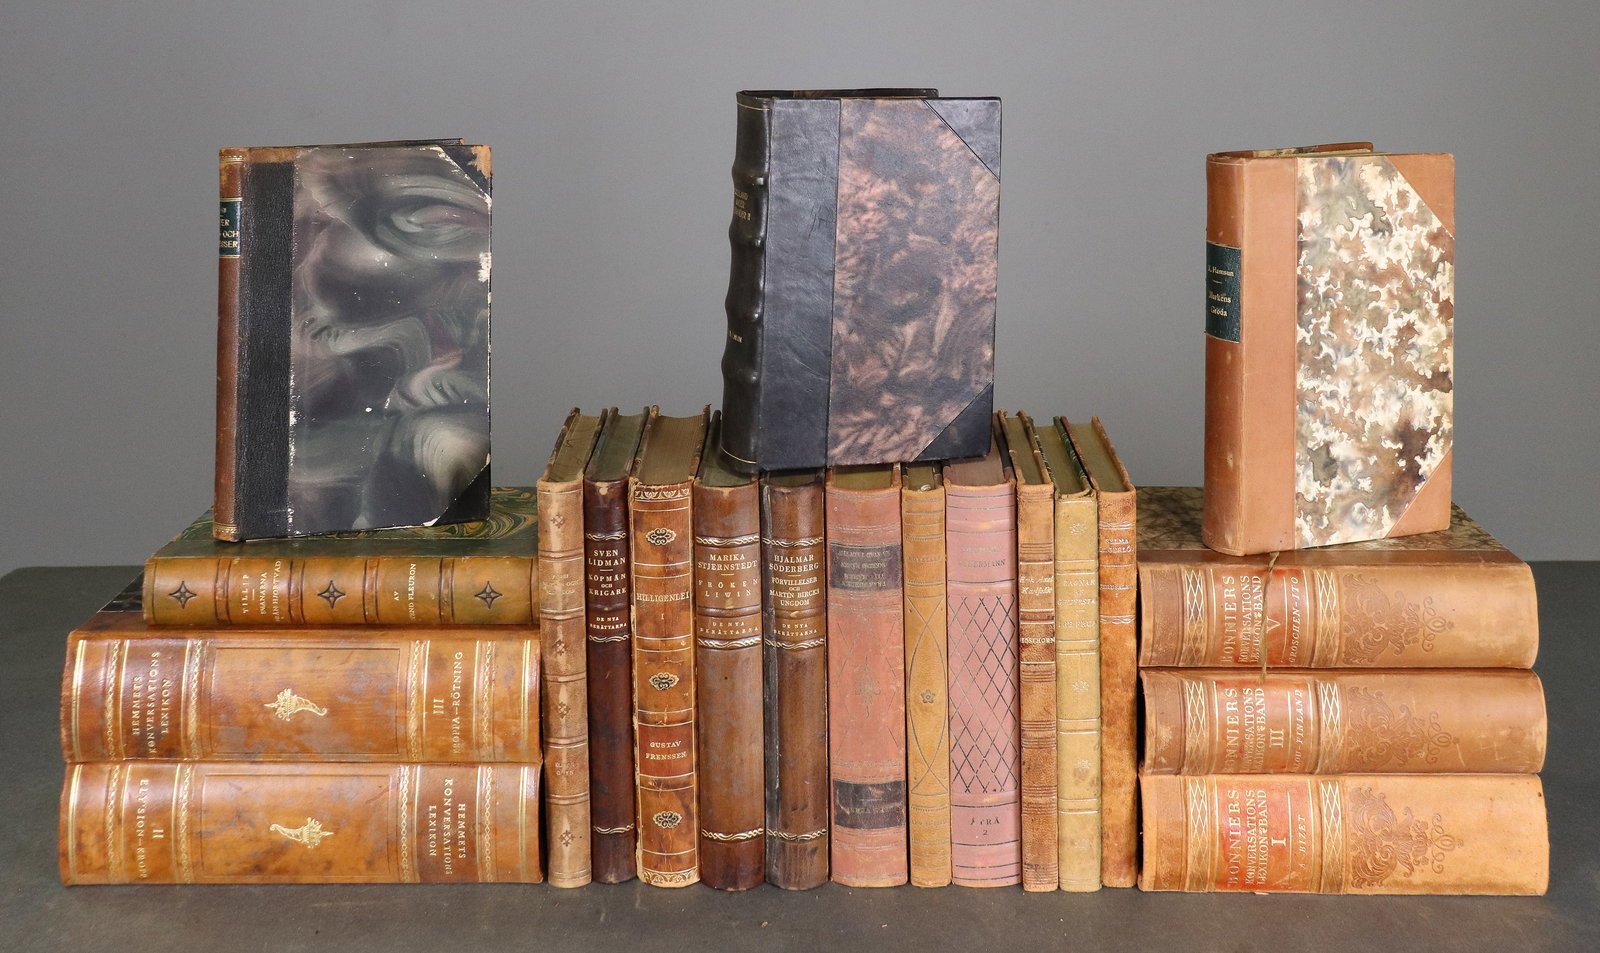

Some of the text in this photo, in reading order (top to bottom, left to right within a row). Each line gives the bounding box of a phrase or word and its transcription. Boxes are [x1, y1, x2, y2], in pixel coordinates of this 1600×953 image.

[222, 230, 239, 238] OCH
[593, 549, 619, 557] SVEN
[709, 553, 746, 561] MARIKA
[588, 557, 626, 567] LIDMAN
[774, 554, 815, 564] HJALMAR
[768, 562, 819, 573] SÖDERBERG
[407, 563, 417, 600] FLEURON
[698, 578, 759, 589] FRÖKEN
[771, 576, 818, 586] FÖRVILLELSER
[393, 591, 400, 601] AV
[588, 588, 627, 597] KRIGARE
[636, 591, 690, 602] HILLIGENLEI
[705, 589, 751, 598] LIWIN
[769, 589, 795, 599] MARTIN
[1251, 575, 1263, 612] BAND
[780, 599, 810, 607] UNGDOM
[660, 612, 665, 620] I
[1221, 575, 1237, 663] BONNIERS
[1266, 615, 1281, 634] V
[131, 676, 143, 736] HEMMETS
[146, 651, 160, 754] KONVERSATIONS
[160, 679, 172, 735] LEXIKON
[432, 698, 445, 715] III
[1254, 687, 1266, 725] BAND
[1269, 728, 1285, 748] III
[649, 740, 682, 749] GUSTAV
[645, 750, 687, 760] FRENSSEN
[428, 805, 437, 857] LEXIKON
[443, 778, 454, 875] KONVERSATIONS
[457, 803, 467, 859] HEMMETS
[152, 829, 164, 839] II
[1227, 789, 1242, 884] BONNIERS
[1245, 789, 1257, 884] KONVERSATIONS
[1256, 790, 1268, 885] LEXIKON BAND
[1271, 836, 1287, 847] I
